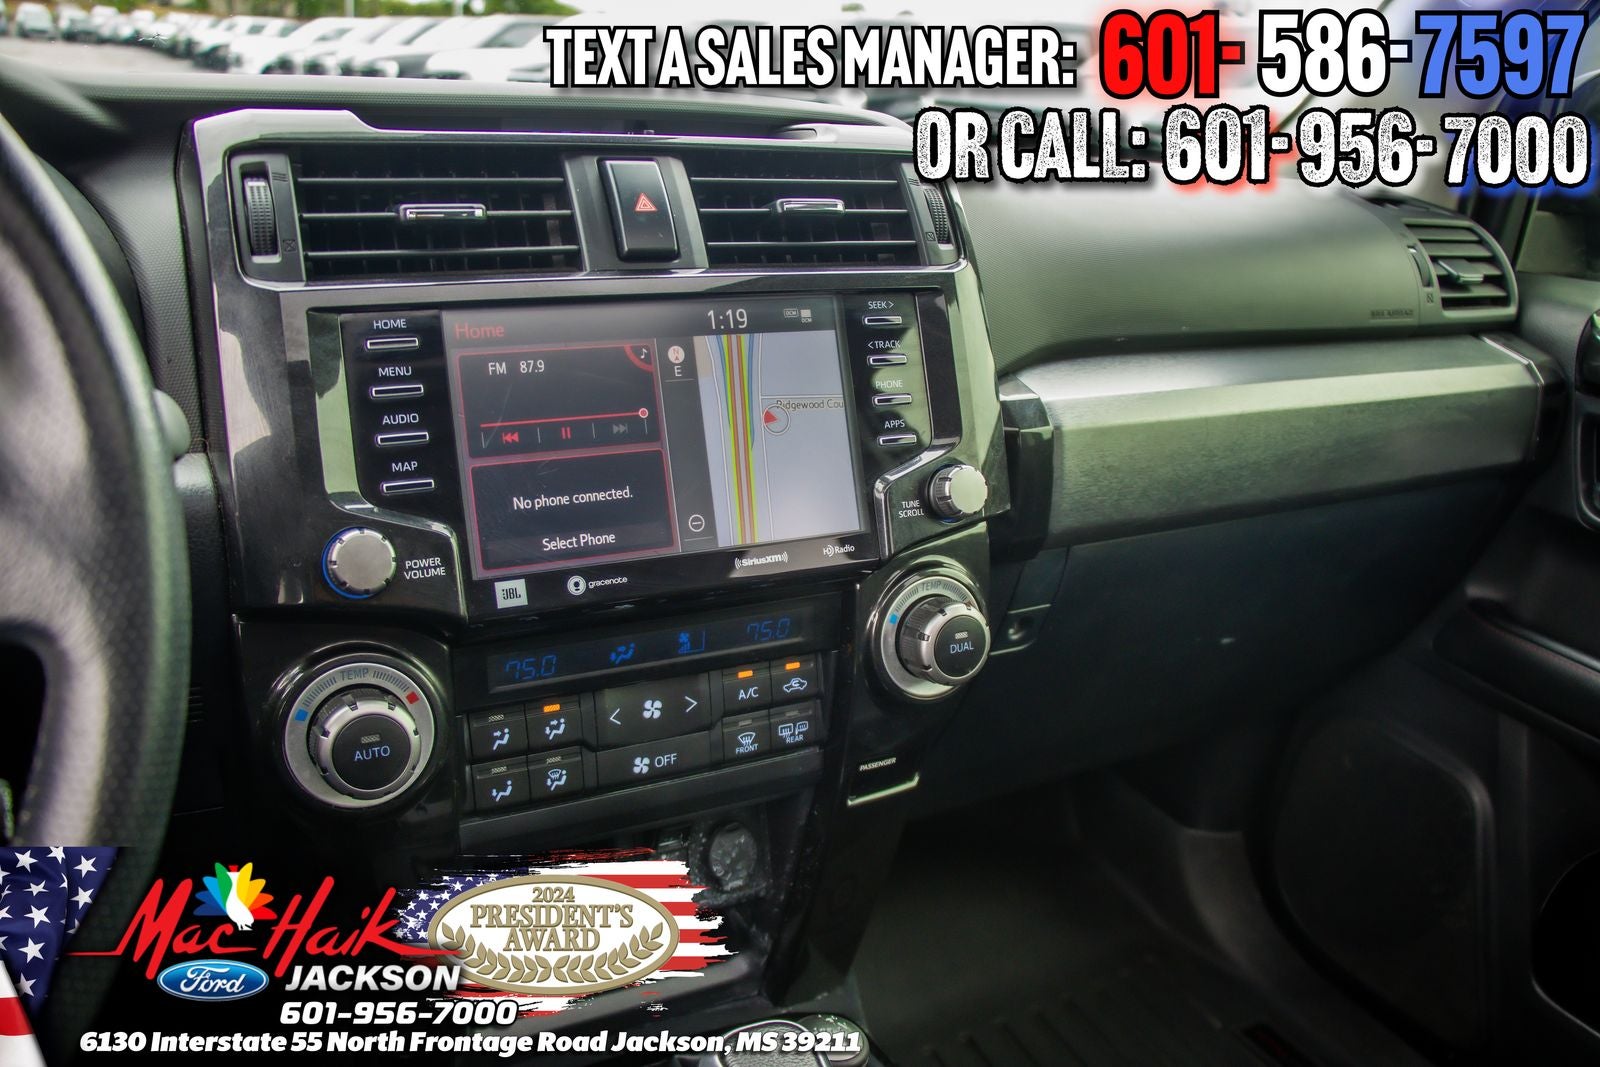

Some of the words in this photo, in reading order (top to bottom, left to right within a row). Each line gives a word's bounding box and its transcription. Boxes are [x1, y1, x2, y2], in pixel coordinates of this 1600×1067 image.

[868, 301, 887, 310] SEEK
[373, 319, 407, 330] HOME
[707, 308, 748, 329] 1:19
[455, 323, 504, 339] Home
[875, 340, 901, 349] TRACK
[378, 366, 412, 377] MENU
[488, 362, 507, 375] FM
[520, 360, 545, 374] 87.9
[674, 365, 682, 377] E
[875, 380, 903, 389] PHONE
[382, 413, 419, 425] AUDIO
[884, 420, 905, 429] APPS
[392, 461, 418, 473] MAP
[513, 496, 531, 510] No
[534, 492, 569, 510] phone
[572, 487, 633, 507] connected.
[902, 500, 920, 508] TUNE
[898, 508, 924, 518] SCROLL
[542, 535, 577, 551] Select
[579, 532, 616, 547] Phone
[405, 557, 442, 569] POWER
[404, 567, 446, 580] VOLUME
[588, 577, 628, 588] gracenote
[922, 580, 942, 592] TEMP
[502, 587, 521, 600] JBL
[949, 642, 975, 654] DUAL
[505, 655, 557, 681] 75.0
[340, 668, 370, 681] TEMP
[738, 686, 759, 700] A/C
[786, 734, 804, 744] REAR
[354, 746, 391, 761] AUTO
[735, 743, 759, 754] FRONT
[655, 753, 678, 768] OFF
[859, 757, 897, 771] PASSENGER
